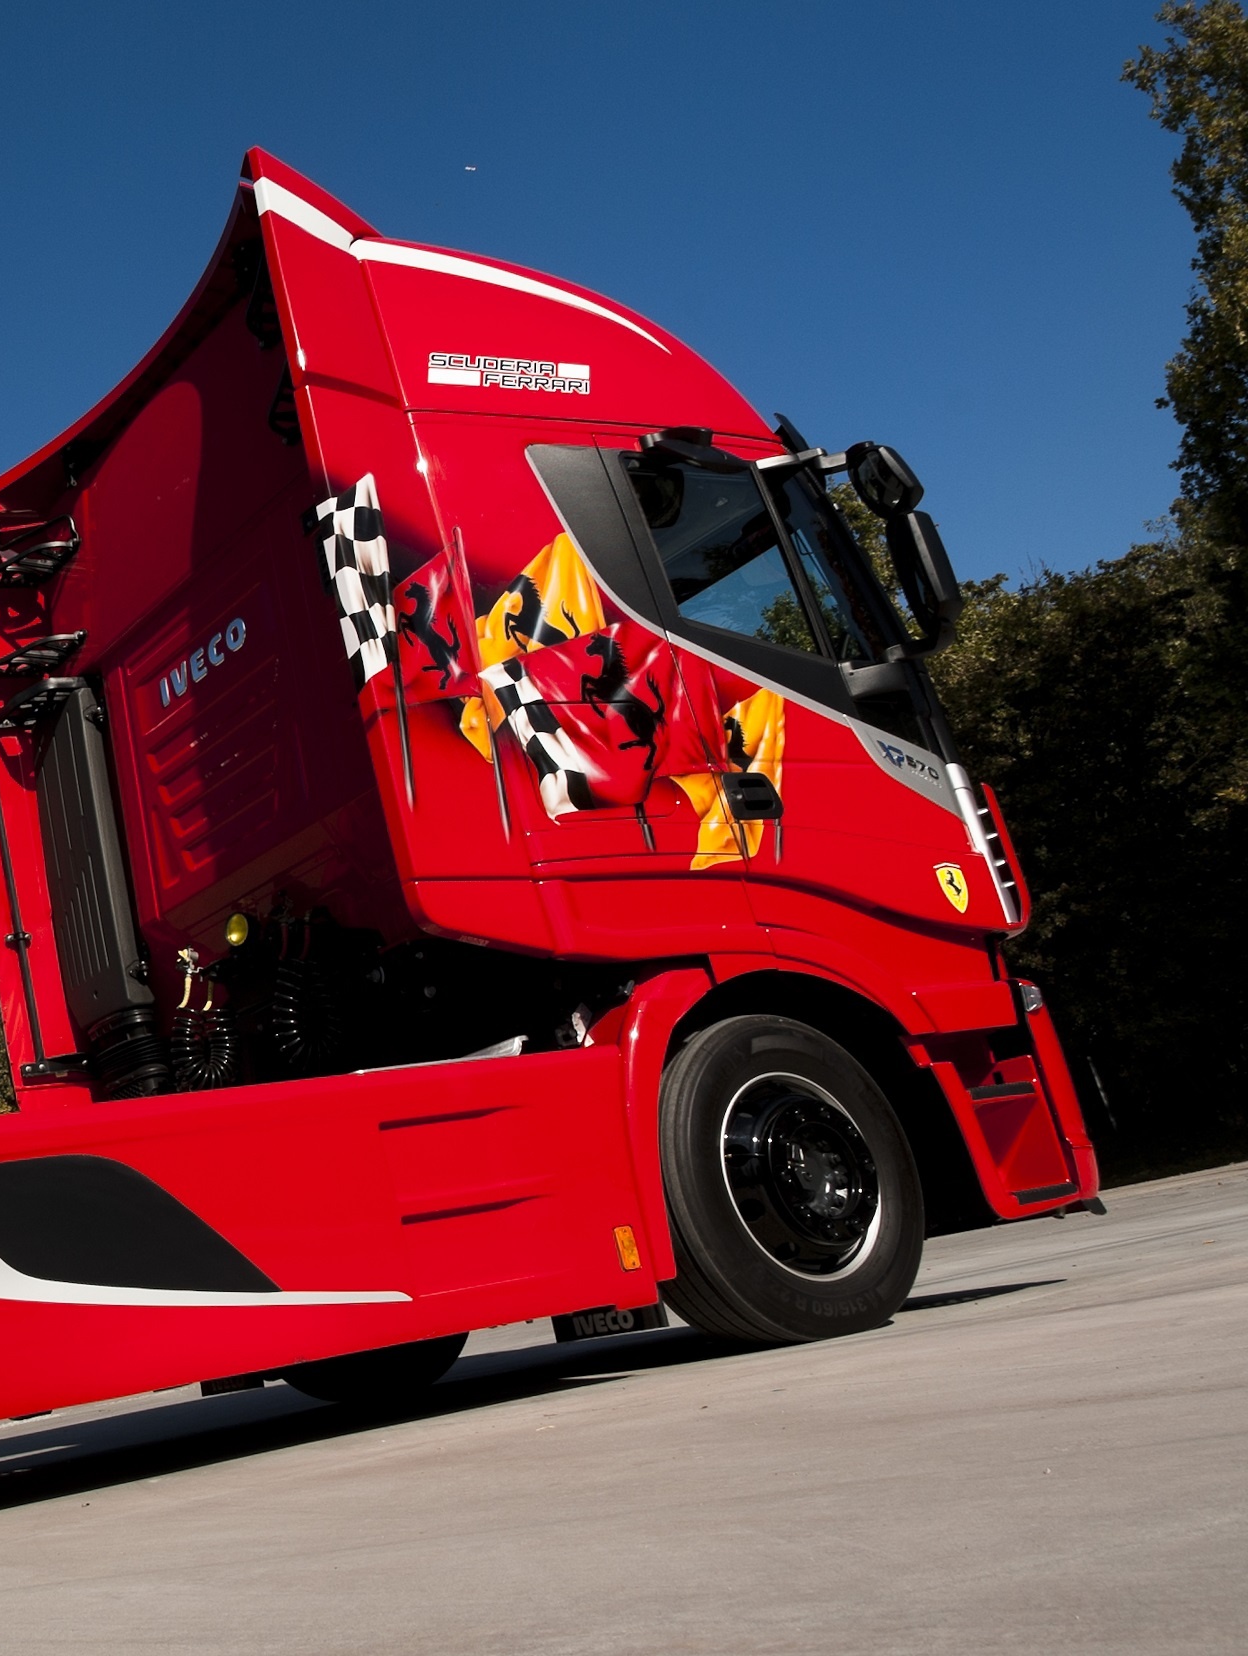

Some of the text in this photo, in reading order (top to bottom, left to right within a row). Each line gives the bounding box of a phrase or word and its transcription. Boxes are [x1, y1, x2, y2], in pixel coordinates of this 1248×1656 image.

[430, 354, 555, 375] SCUDERIA
[484, 373, 588, 393] FERRARI
[159, 617, 246, 708] IVECO
[905, 754, 939, 780] 570
[572, 1310, 634, 1337] IVECO
